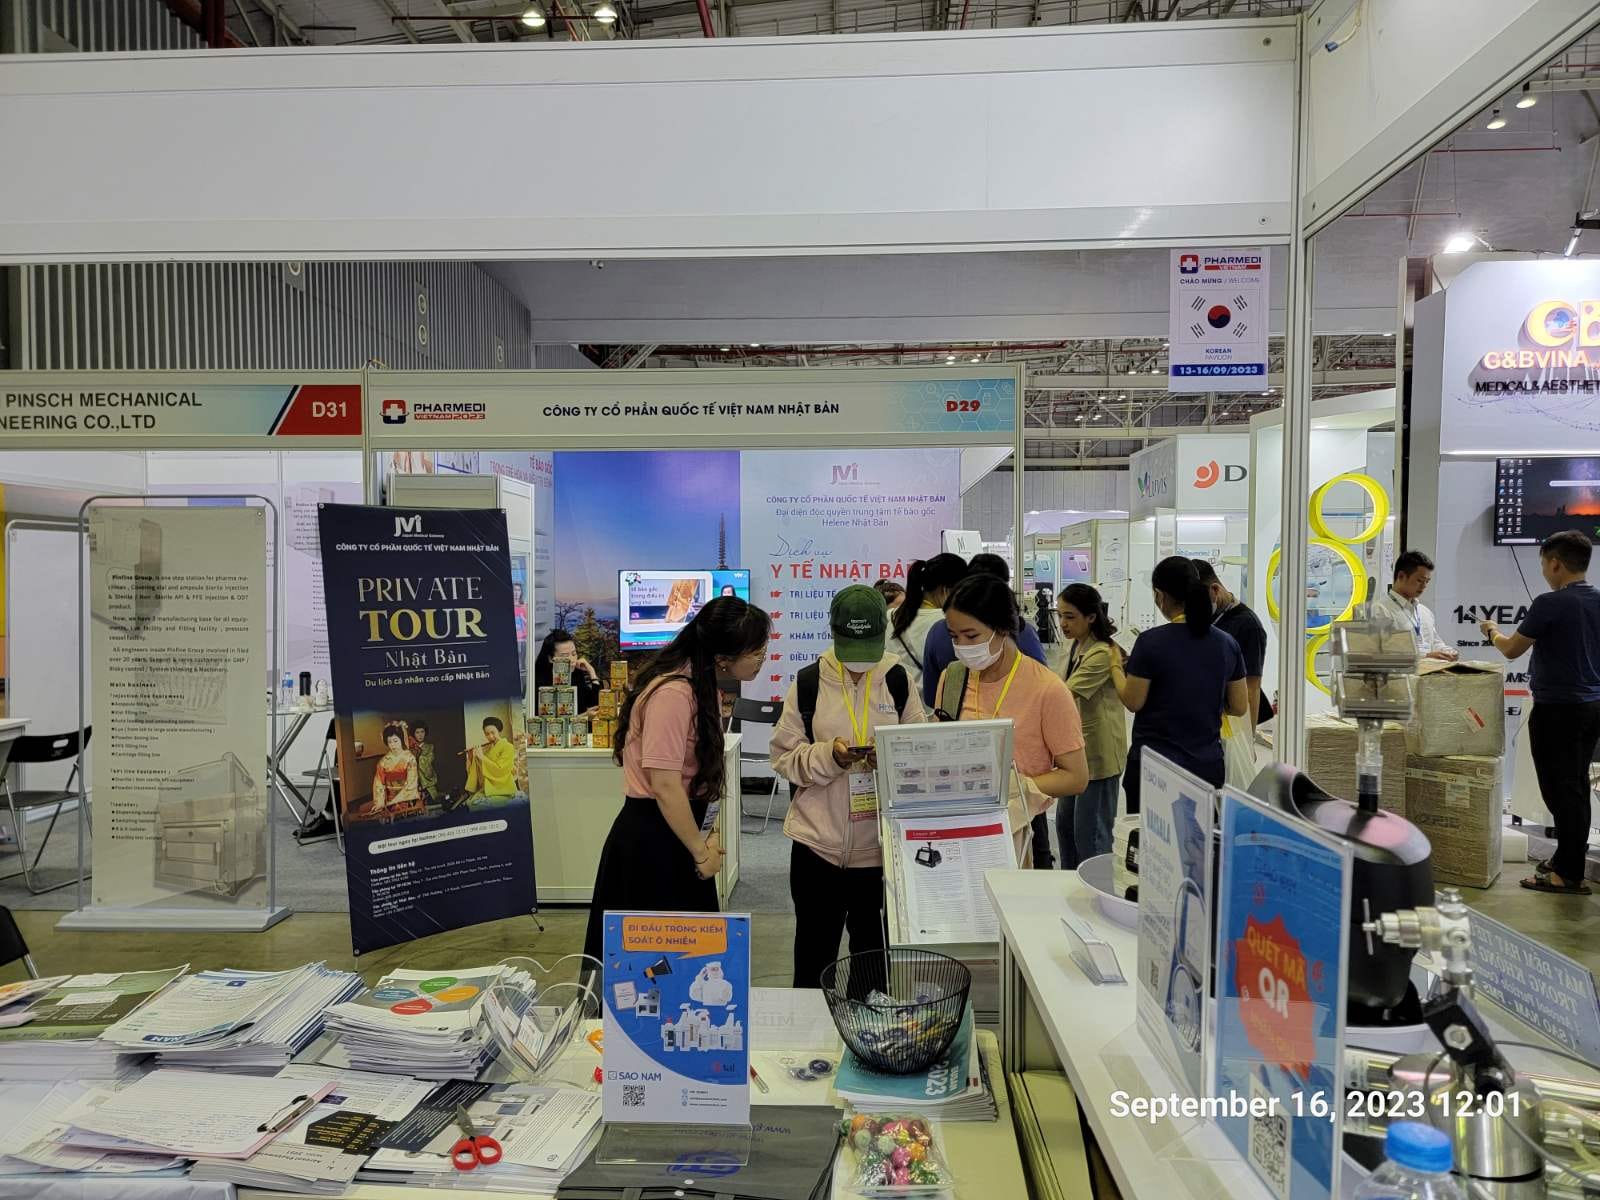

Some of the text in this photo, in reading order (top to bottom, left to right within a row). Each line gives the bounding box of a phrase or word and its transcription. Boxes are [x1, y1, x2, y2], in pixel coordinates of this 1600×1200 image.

[1204, 256, 1261, 264] PHARMEDI
[1179, 366, 1258, 375] 13-16/09/2023
[6, 392, 202, 408] PINSCH MECHANICAL
[414, 403, 485, 413] PHARMEDI
[946, 400, 980, 412] D29
[312, 402, 347, 418] D31
[543, 402, 839, 418] CÔNG TY CỔ PHẦN QUỐC TẾ VIỆT NAM NHẬT BẢN
[0, 414, 156, 430] NEERING CO.,LTD
[1224, 464, 1247, 482] D
[766, 495, 787, 503] CÔNG
[822, 519, 850, 527] Helene
[336, 542, 357, 551] CÔNG
[770, 558, 911, 582] Y TẾ NHẬT BẢ
[790, 591, 803, 600] TRỊ
[806, 590, 823, 600] LIỆU
[790, 612, 803, 620] TRỊ
[806, 610, 824, 620] LIỆU
[1454, 605, 1529, 624] 14 YEA
[360, 608, 488, 642] TOUR
[385, 648, 467, 669] Nhật Bản
[365, 679, 377, 687] Du
[378, 677, 392, 687] lịch
[405, 676, 424, 684] nhân
[456, 672, 474, 682] Nhật
[476, 671, 490, 679] Bản
[666, 924, 697, 933] TRONG
[1258, 968, 1289, 1019] QR
[619, 1072, 662, 1082] SAO NAM
[926, 1060, 950, 1096] 2023
